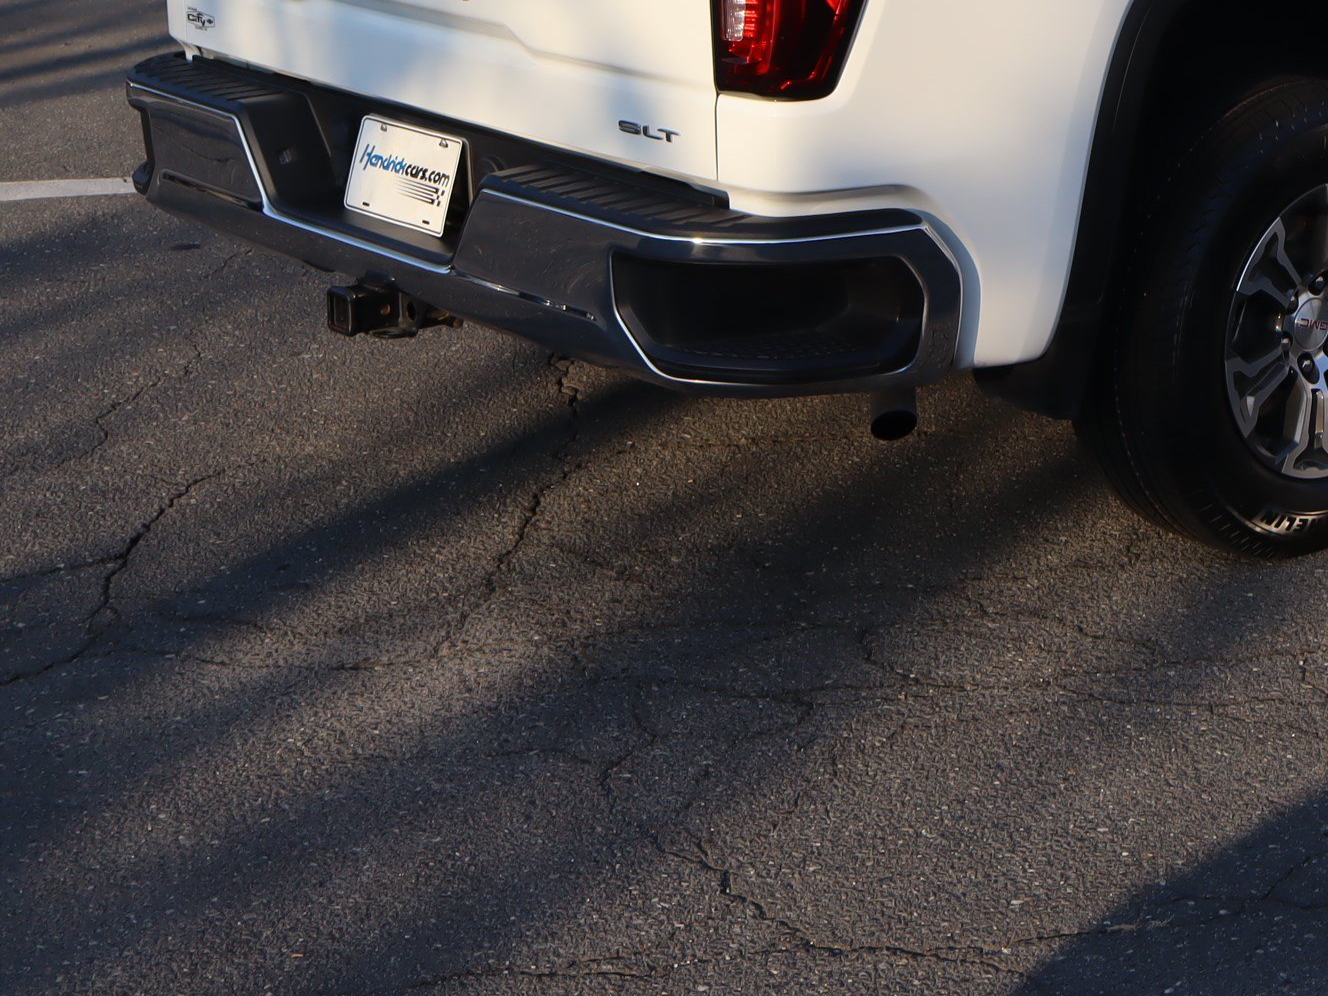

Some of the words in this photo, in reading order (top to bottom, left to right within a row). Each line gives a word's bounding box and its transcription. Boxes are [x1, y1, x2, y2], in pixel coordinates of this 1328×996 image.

[618, 119, 680, 143] SLT
[359, 143, 451, 187] Hendrickcars.com
[1300, 318, 1328, 331] GMC
